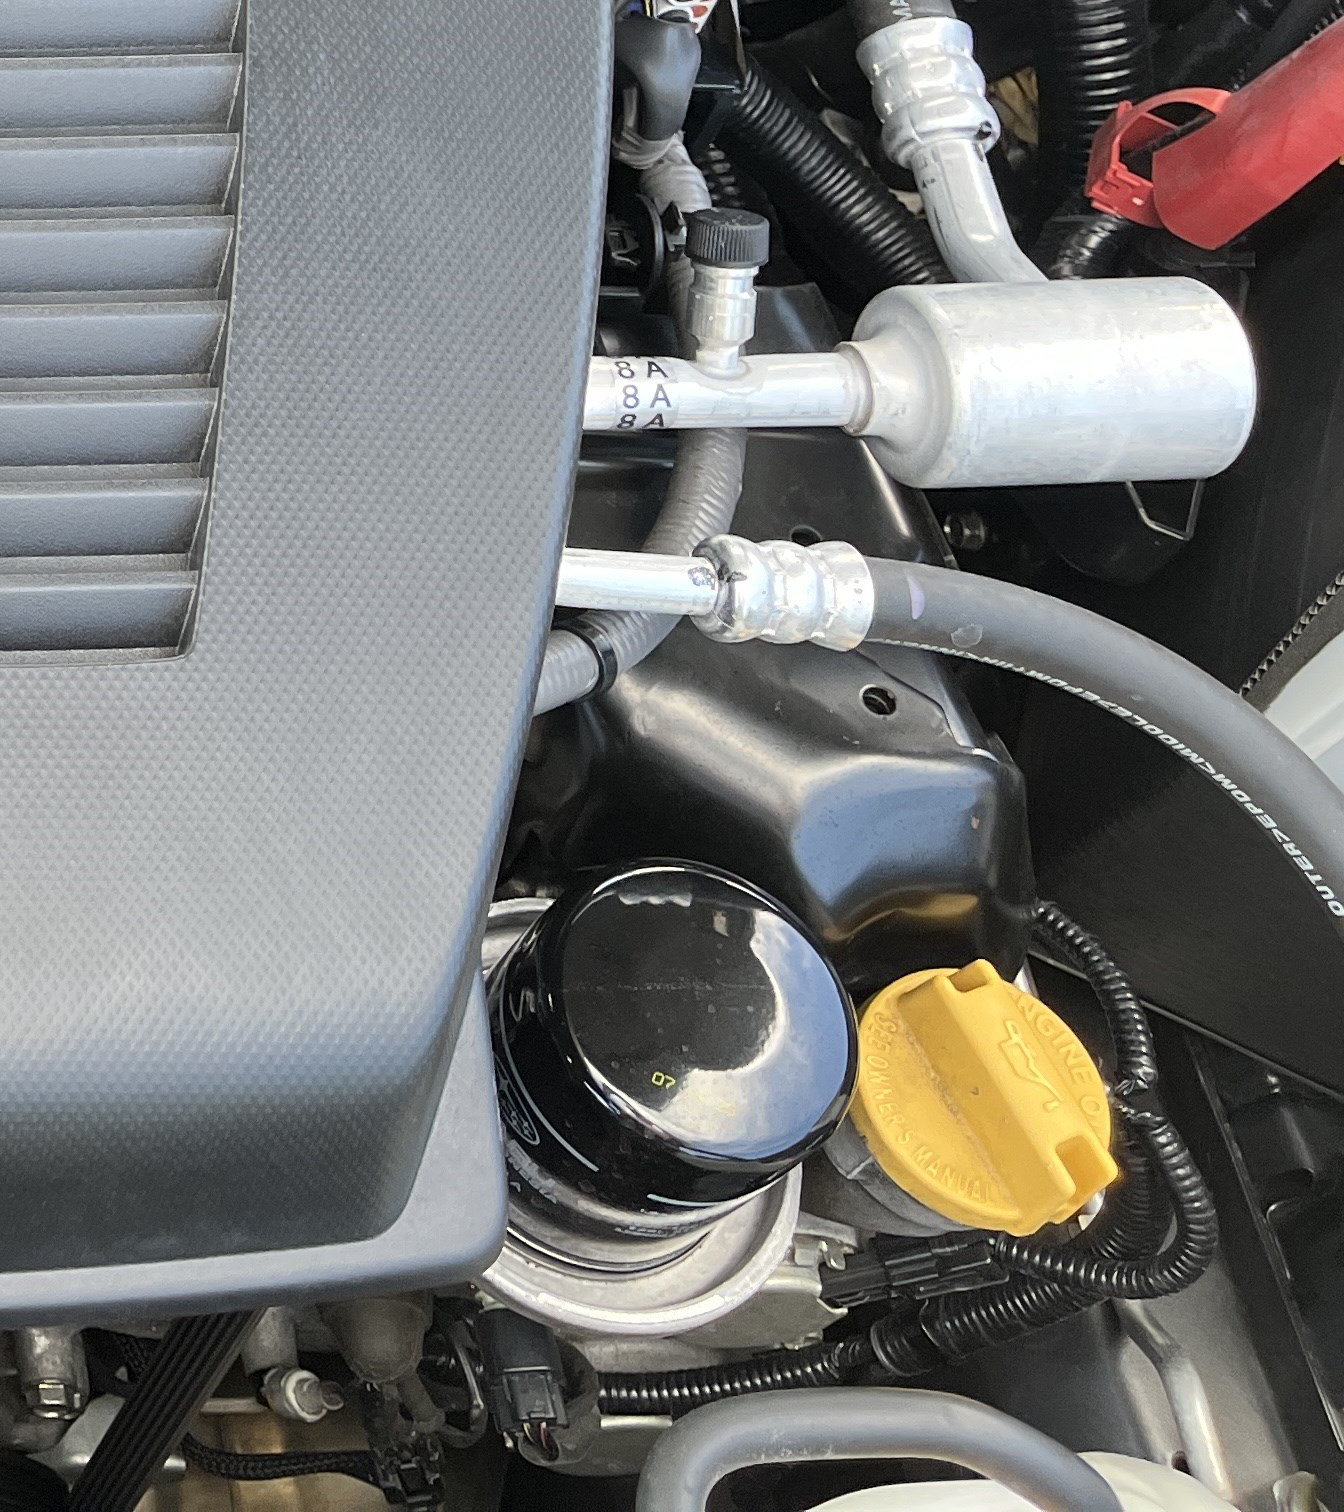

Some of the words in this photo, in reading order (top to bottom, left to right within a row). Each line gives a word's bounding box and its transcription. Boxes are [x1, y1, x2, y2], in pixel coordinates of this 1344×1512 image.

[614, 360, 636, 379] 8
[646, 360, 669, 378] A
[622, 384, 641, 409] 8
[649, 383, 672, 409] A
[617, 413, 637, 429] 8
[641, 412, 665, 429] A
[651, 1071, 676, 1089] 07
